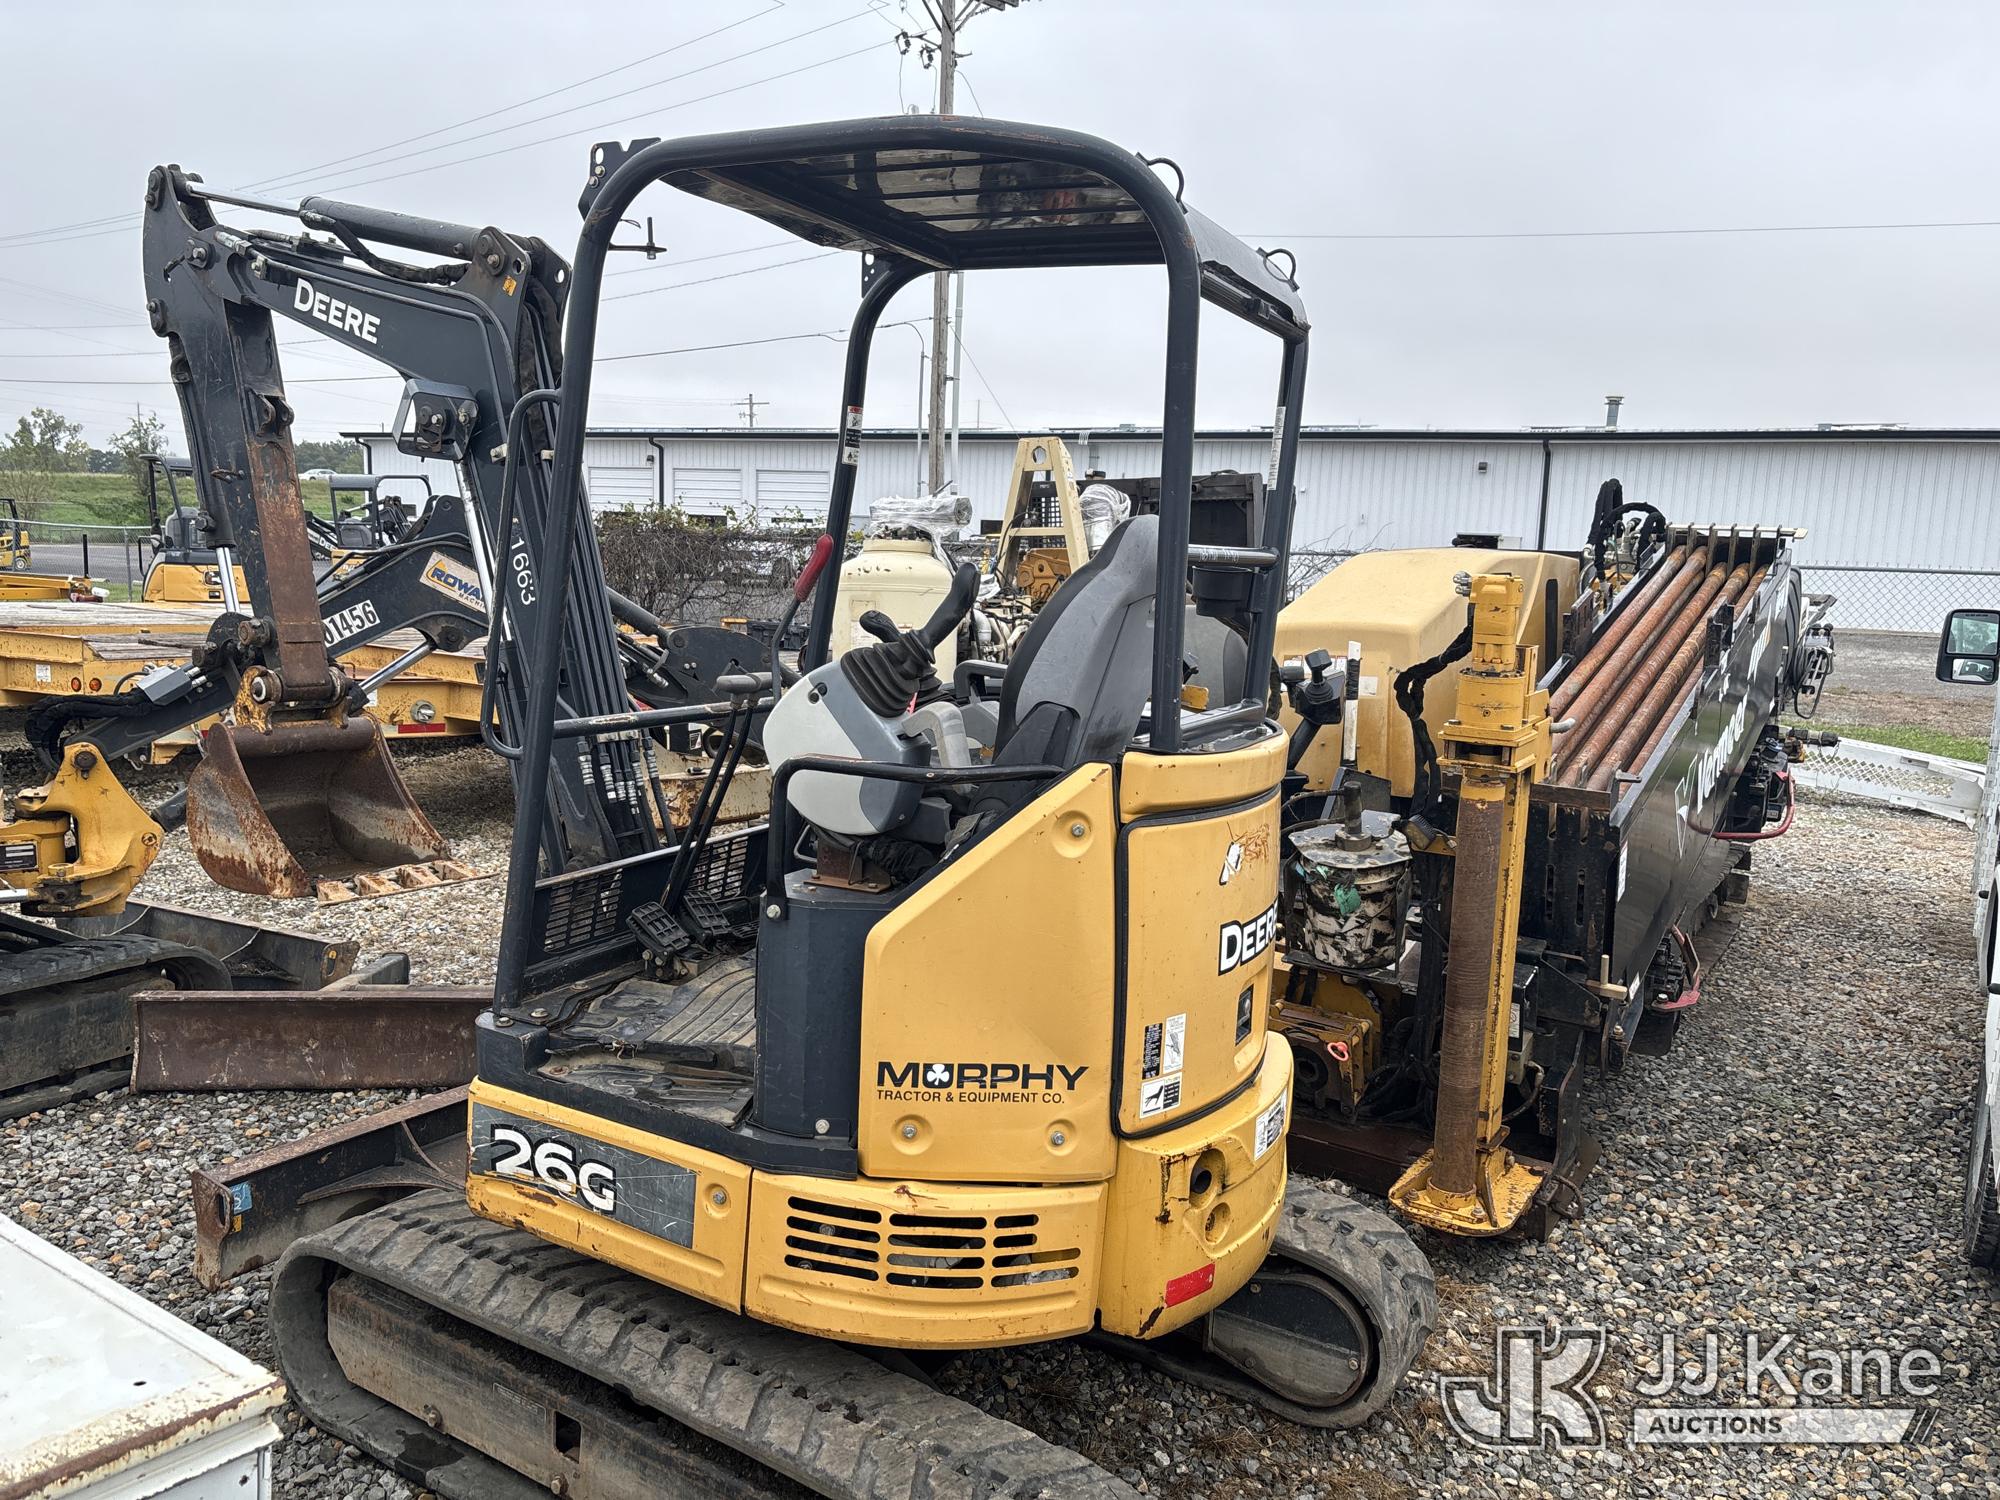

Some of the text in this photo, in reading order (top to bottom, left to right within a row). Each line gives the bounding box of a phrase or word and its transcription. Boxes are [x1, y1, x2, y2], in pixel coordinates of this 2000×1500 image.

[294, 277, 380, 345] DEERE
[431, 567, 484, 601] ROWA
[511, 537, 535, 605] 1663
[458, 592, 486, 609] MACHI
[877, 1090, 1065, 1104] TRACTOR & EQUIPMENT CO.
[492, 1125, 616, 1213] 26G
